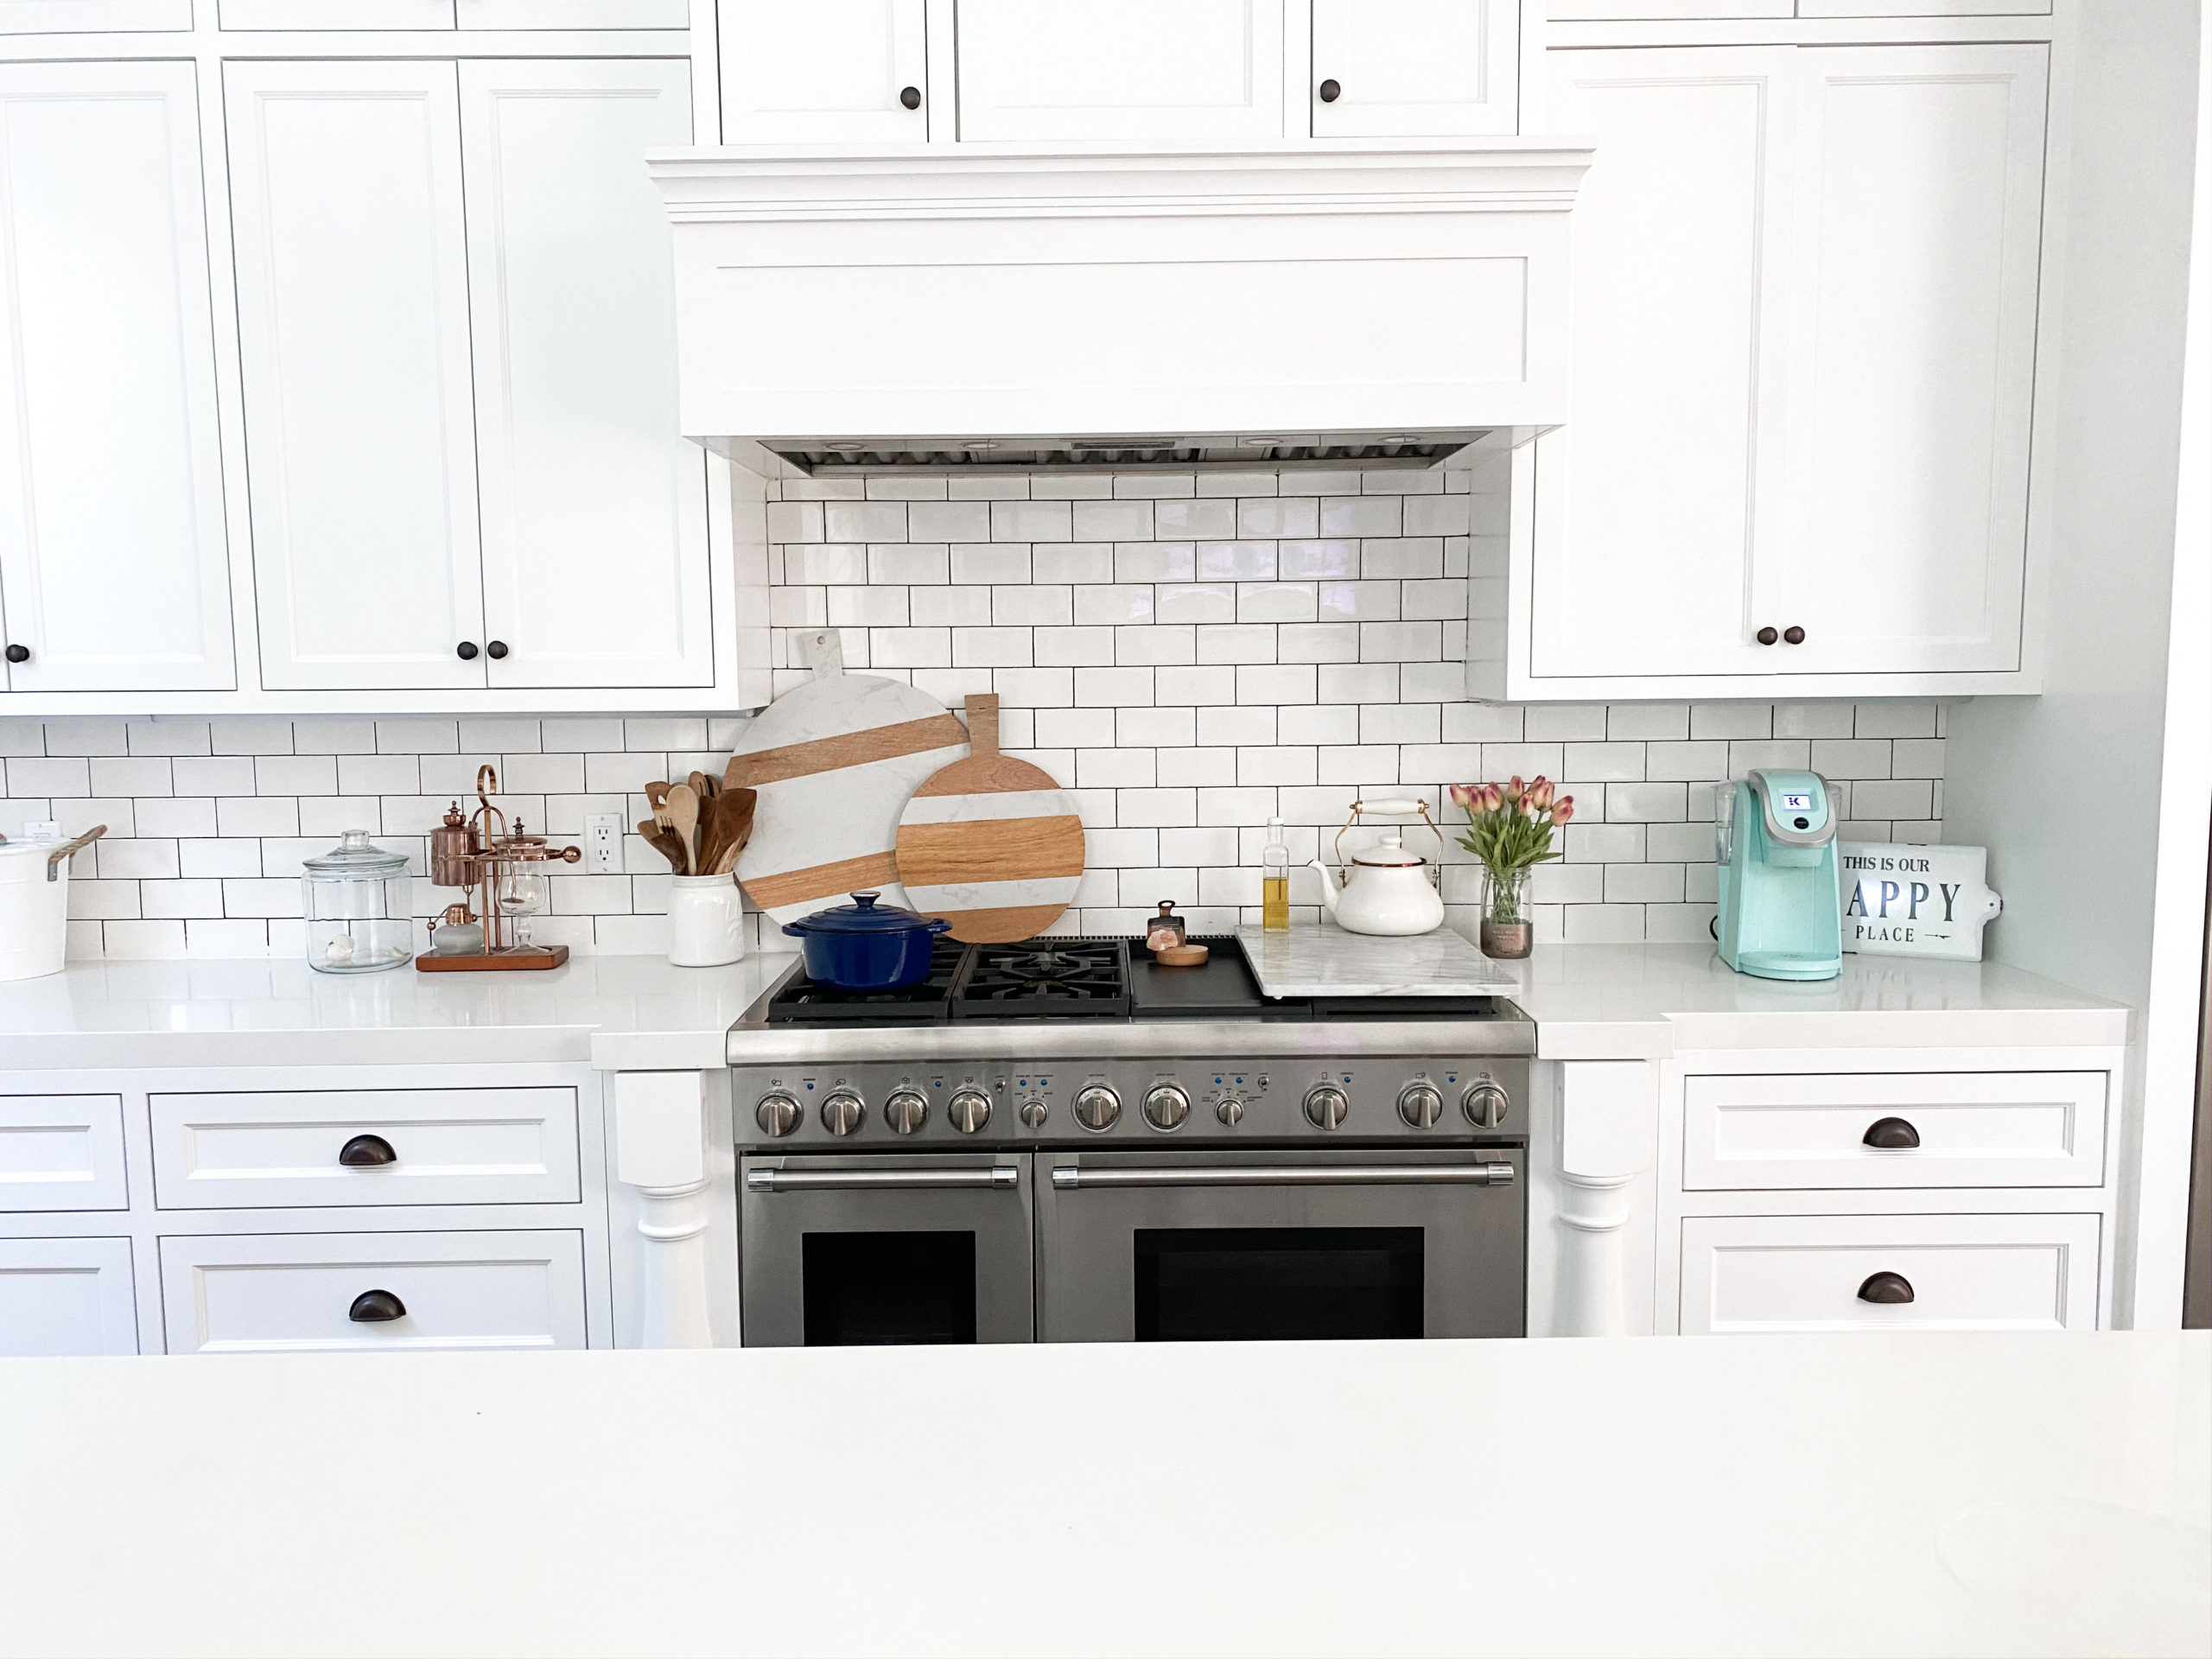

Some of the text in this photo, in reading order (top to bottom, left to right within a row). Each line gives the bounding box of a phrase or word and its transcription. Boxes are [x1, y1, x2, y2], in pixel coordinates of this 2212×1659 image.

[1843, 855, 1930, 873] THIS IS OUR
[1846, 879, 1961, 922] APPY
[1855, 925, 1914, 943] PLACE
